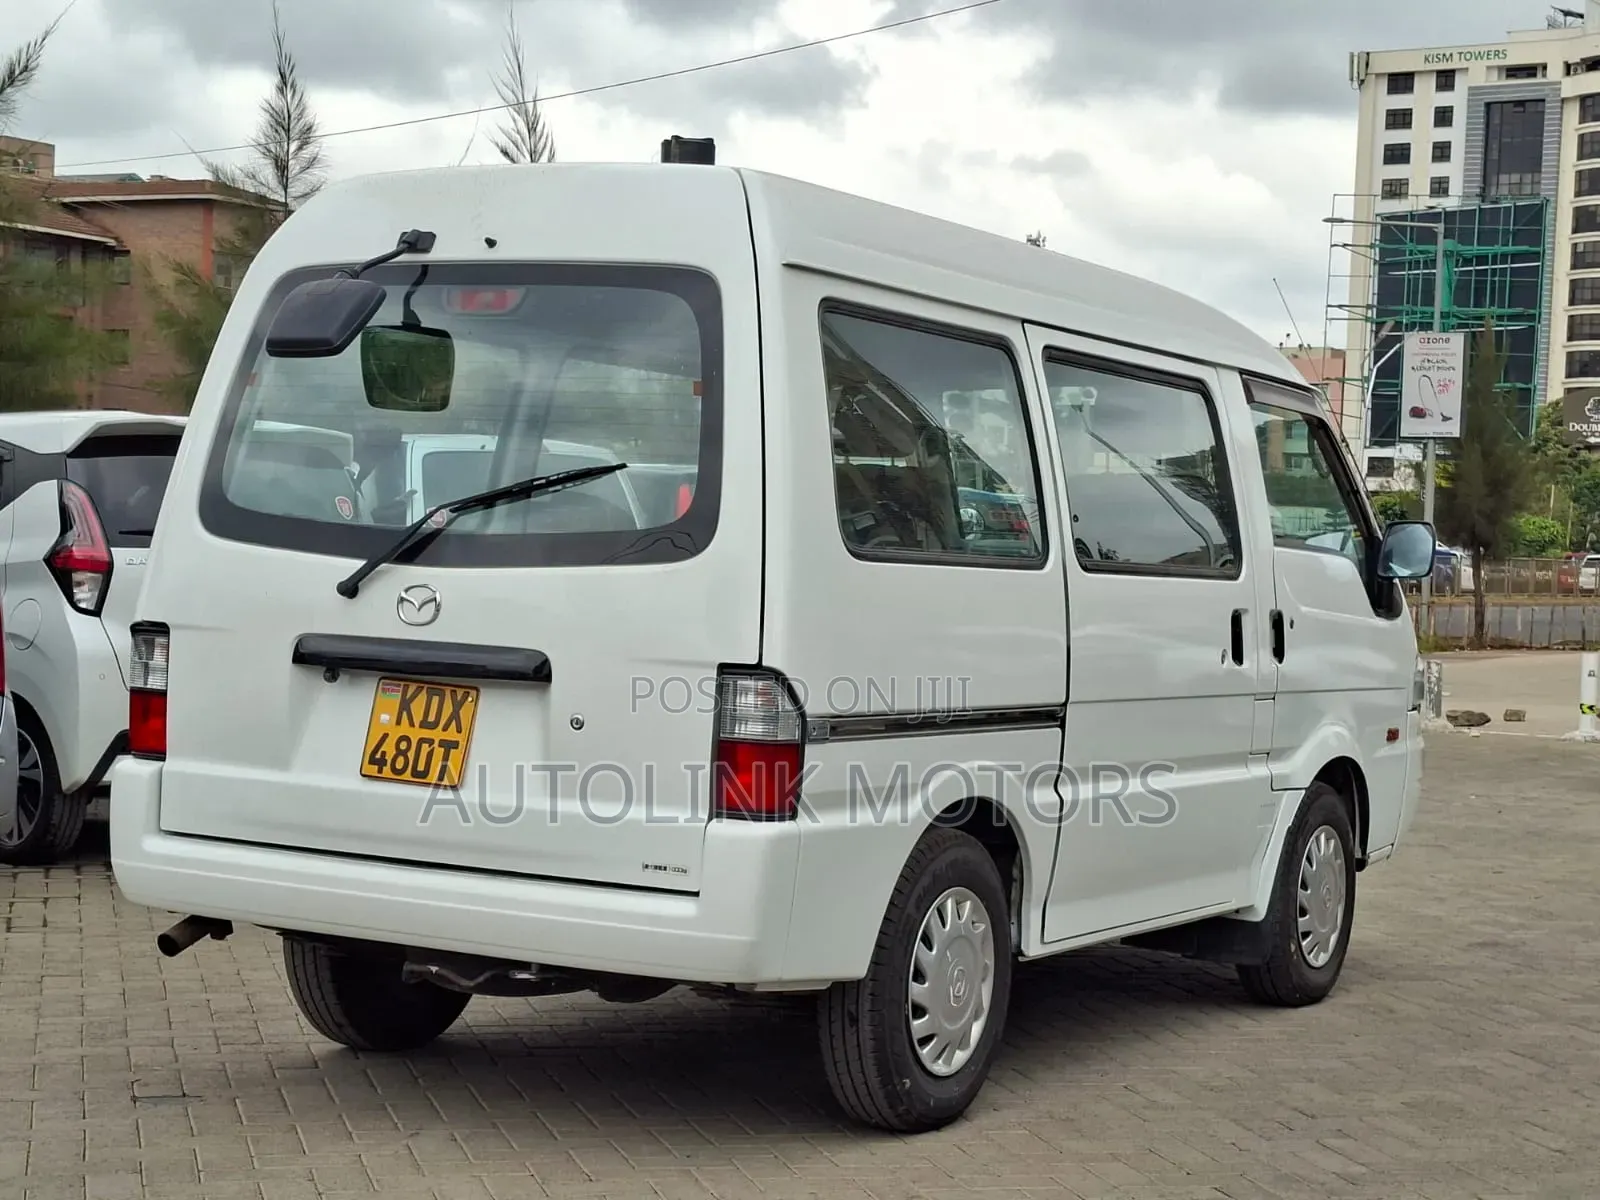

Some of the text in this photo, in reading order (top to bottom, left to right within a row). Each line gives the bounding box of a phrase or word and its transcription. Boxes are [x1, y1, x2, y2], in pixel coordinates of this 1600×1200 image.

[1423, 49, 1508, 65] KISM TOWERS
[395, 683, 471, 734] KDX
[367, 732, 461, 782] 480T
